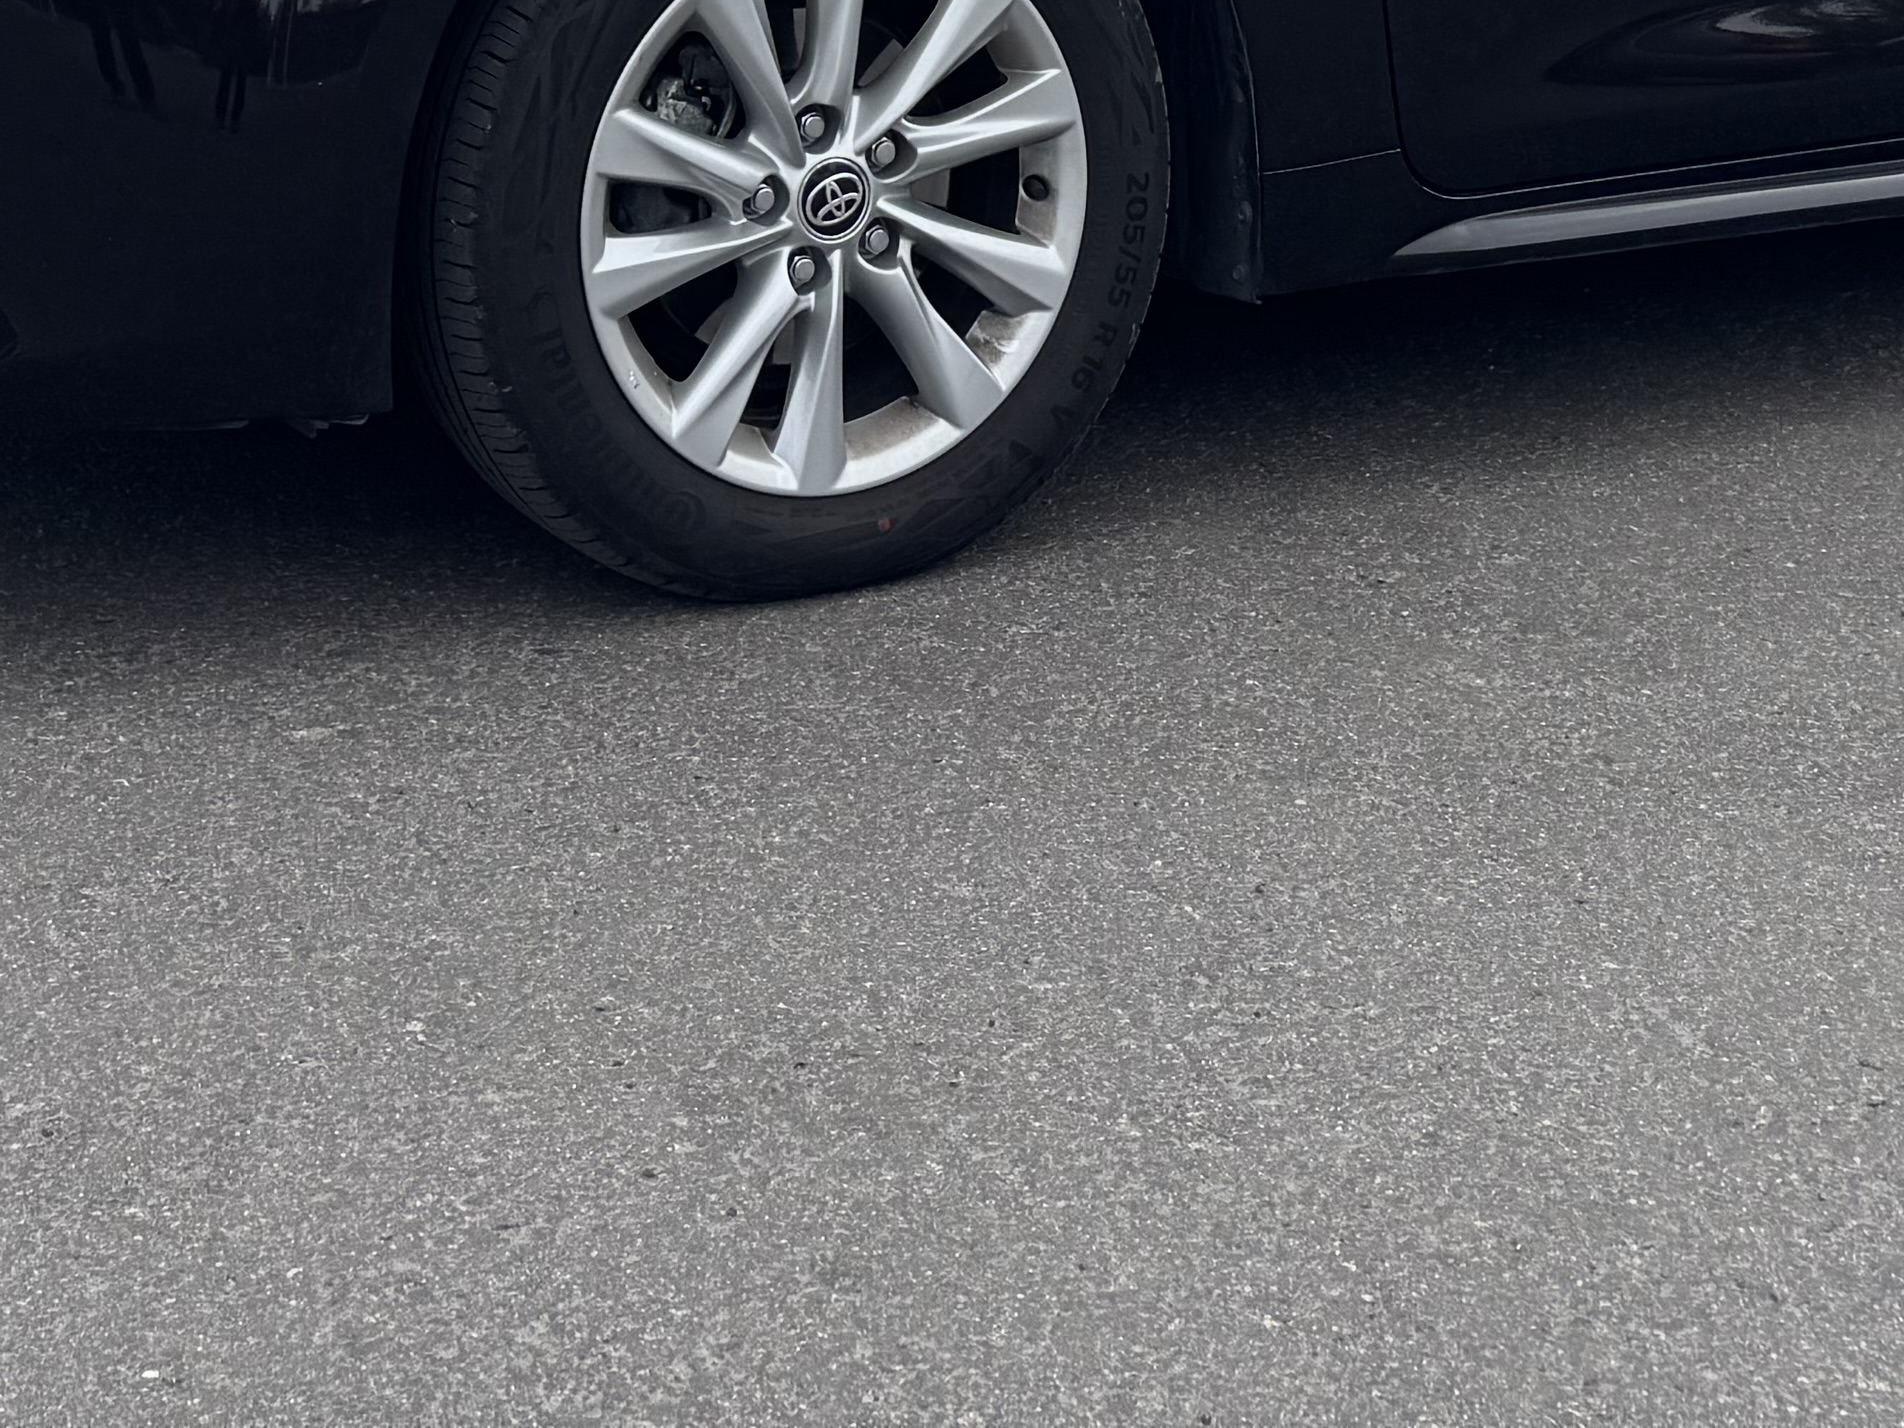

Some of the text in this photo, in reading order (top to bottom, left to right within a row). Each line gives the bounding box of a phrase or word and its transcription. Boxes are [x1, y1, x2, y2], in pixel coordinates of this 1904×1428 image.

[1107, 171, 1150, 310] 205/55
[1092, 319, 1119, 348] R
[1070, 352, 1104, 392] 16
